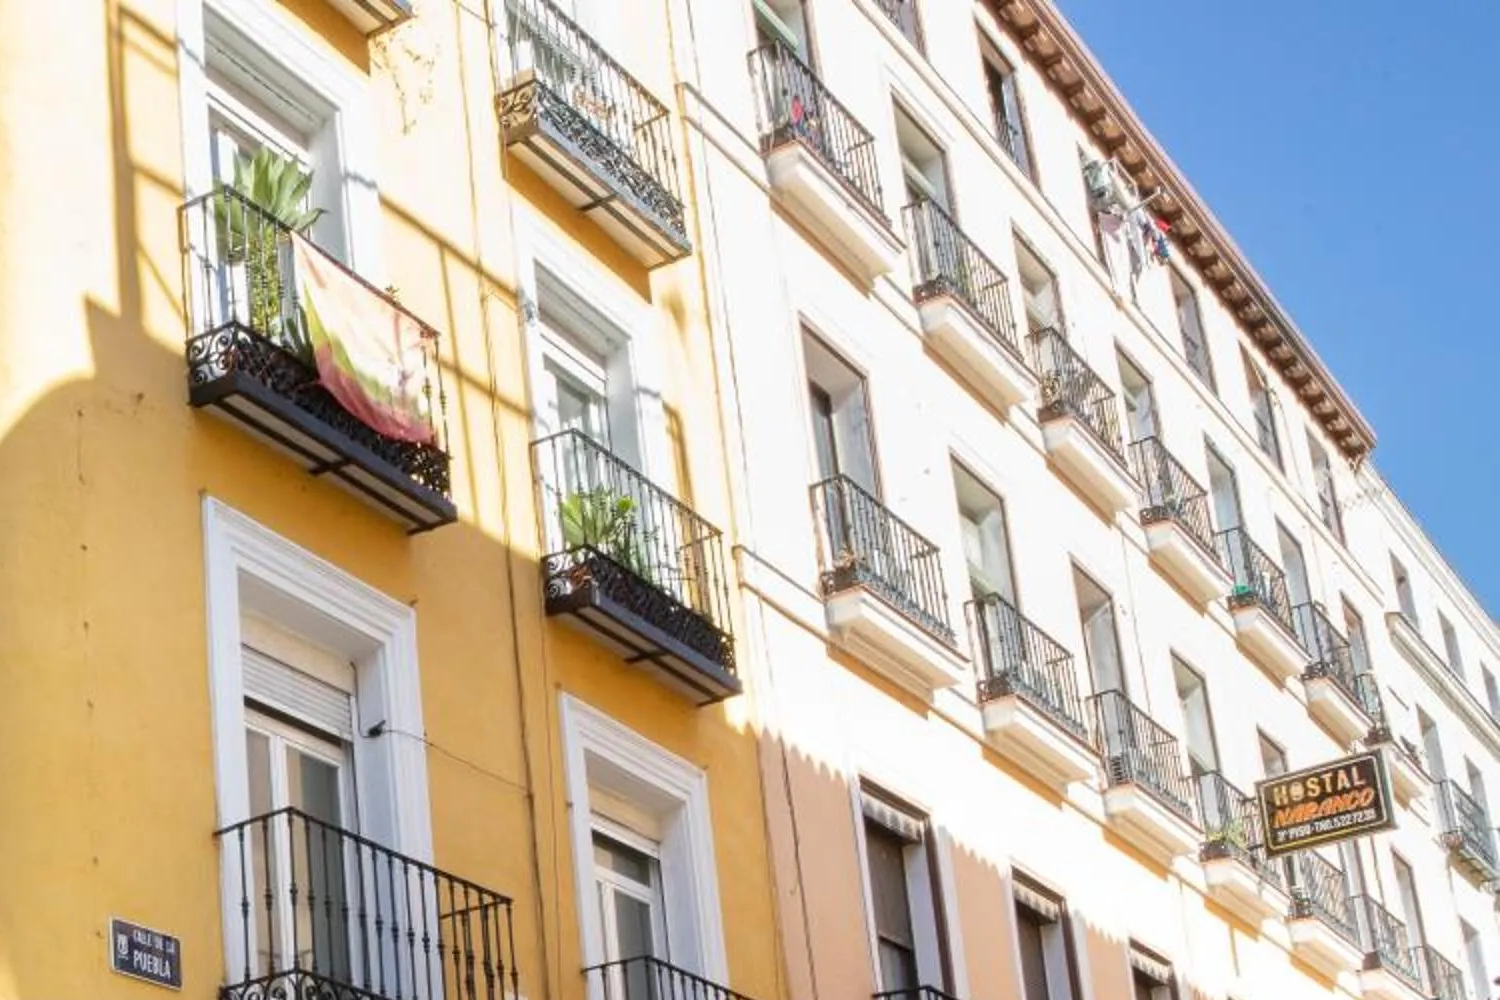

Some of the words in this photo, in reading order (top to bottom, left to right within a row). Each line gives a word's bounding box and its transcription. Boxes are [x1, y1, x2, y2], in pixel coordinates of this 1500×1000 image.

[1272, 766, 1366, 806] HOSTAL
[1272, 787, 1375, 829] NARANCO
[133, 949, 172, 980] PUEBLA
